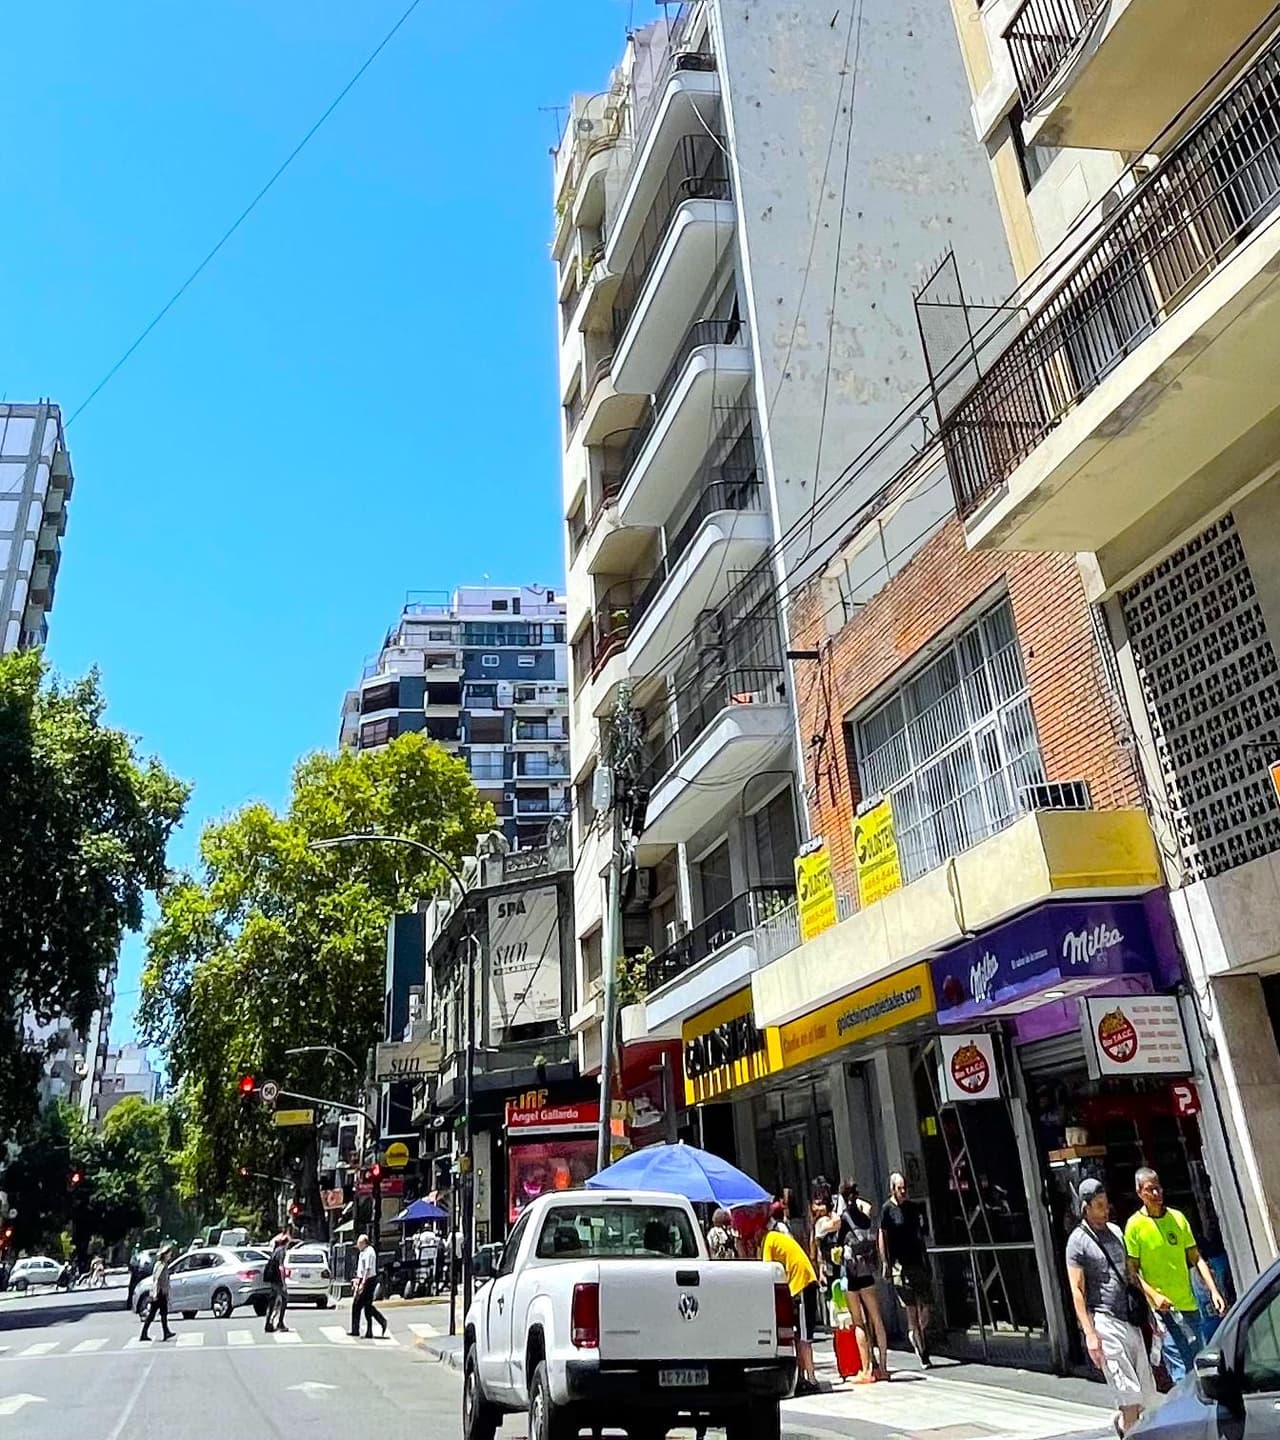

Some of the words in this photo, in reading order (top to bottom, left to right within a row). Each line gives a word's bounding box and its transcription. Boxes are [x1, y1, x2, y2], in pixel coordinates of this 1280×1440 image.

[497, 897, 527, 919] SPA
[1062, 922, 1124, 966] Milka
[970, 950, 999, 1004] Milka
[511, 1110, 539, 1124] Angel
[540, 1108, 579, 1120] Gallardo
